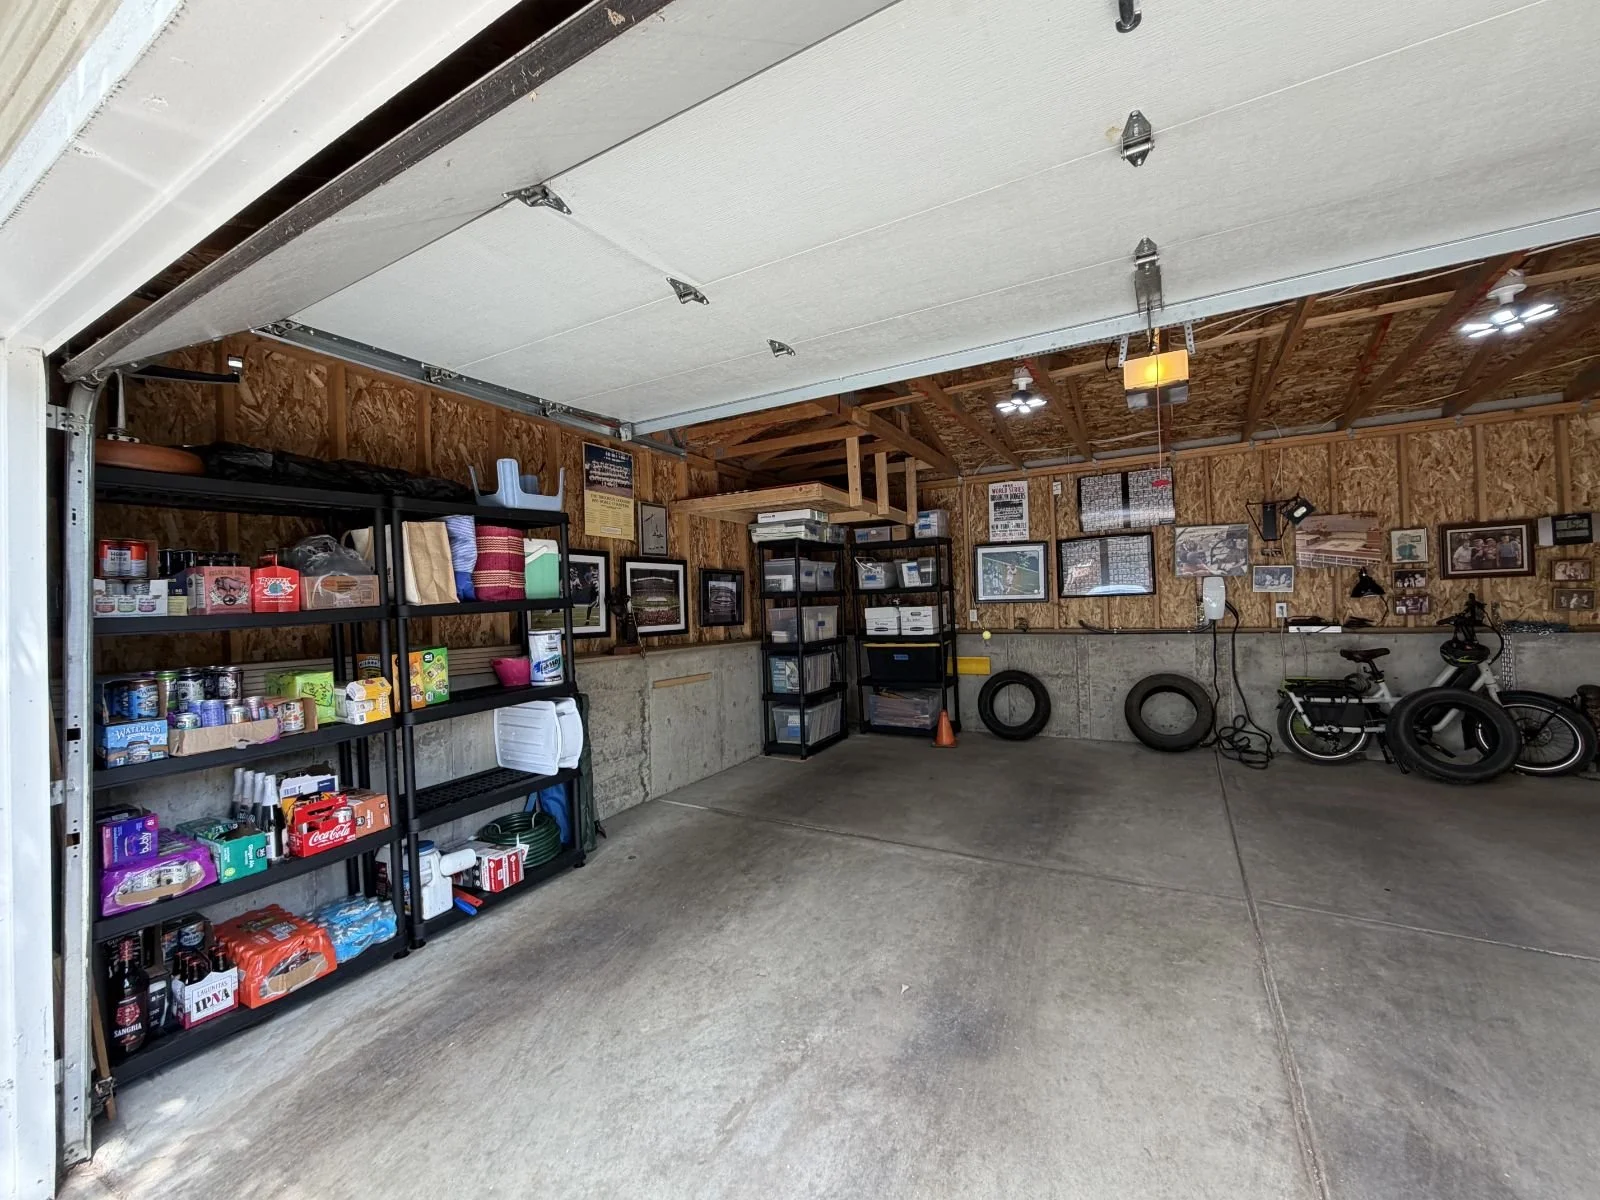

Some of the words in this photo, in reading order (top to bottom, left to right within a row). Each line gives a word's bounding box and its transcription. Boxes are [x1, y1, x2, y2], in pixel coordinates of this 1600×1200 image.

[116, 725, 162, 740] WATERLOO
[139, 832, 151, 854] bubly
[197, 980, 229, 998] LAGUNITAS
[113, 1022, 143, 1038] SANGRIA
